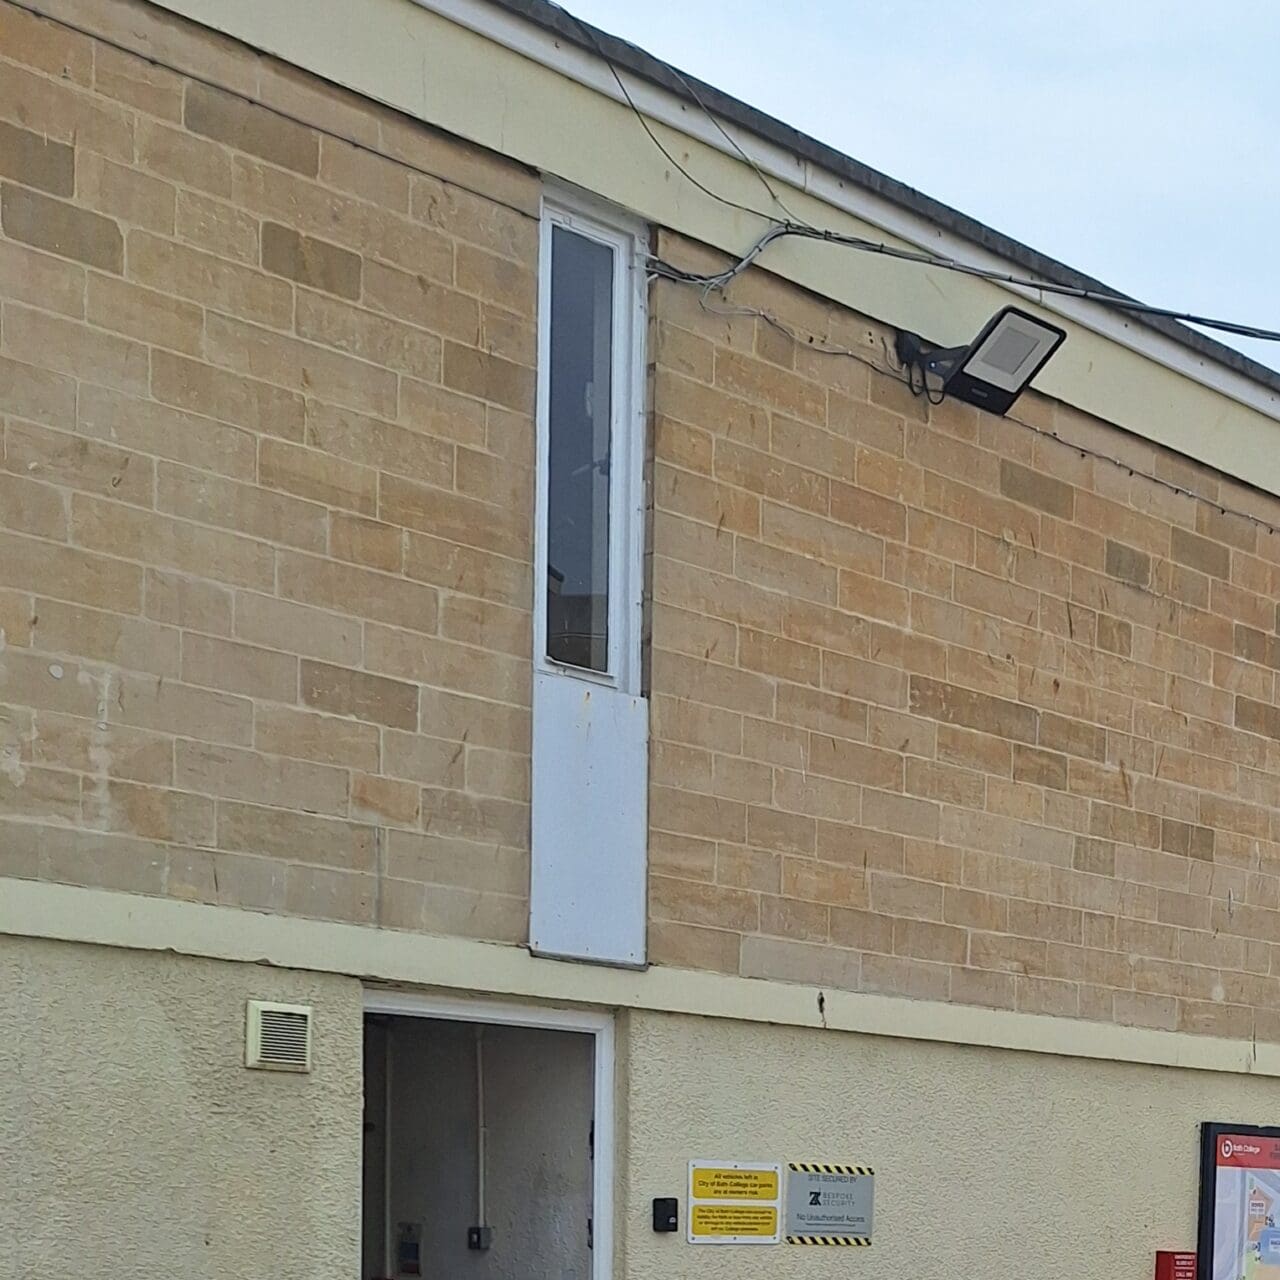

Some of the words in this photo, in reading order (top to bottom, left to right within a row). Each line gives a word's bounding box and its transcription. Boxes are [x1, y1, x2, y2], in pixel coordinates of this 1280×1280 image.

[1243, 1144, 1261, 1154] College
[808, 1174, 820, 1182] SITE
[821, 1174, 849, 1183] SECURED
[849, 1176, 858, 1184] BY
[729, 1181, 749, 1189] College
[796, 1213, 806, 1221] No
